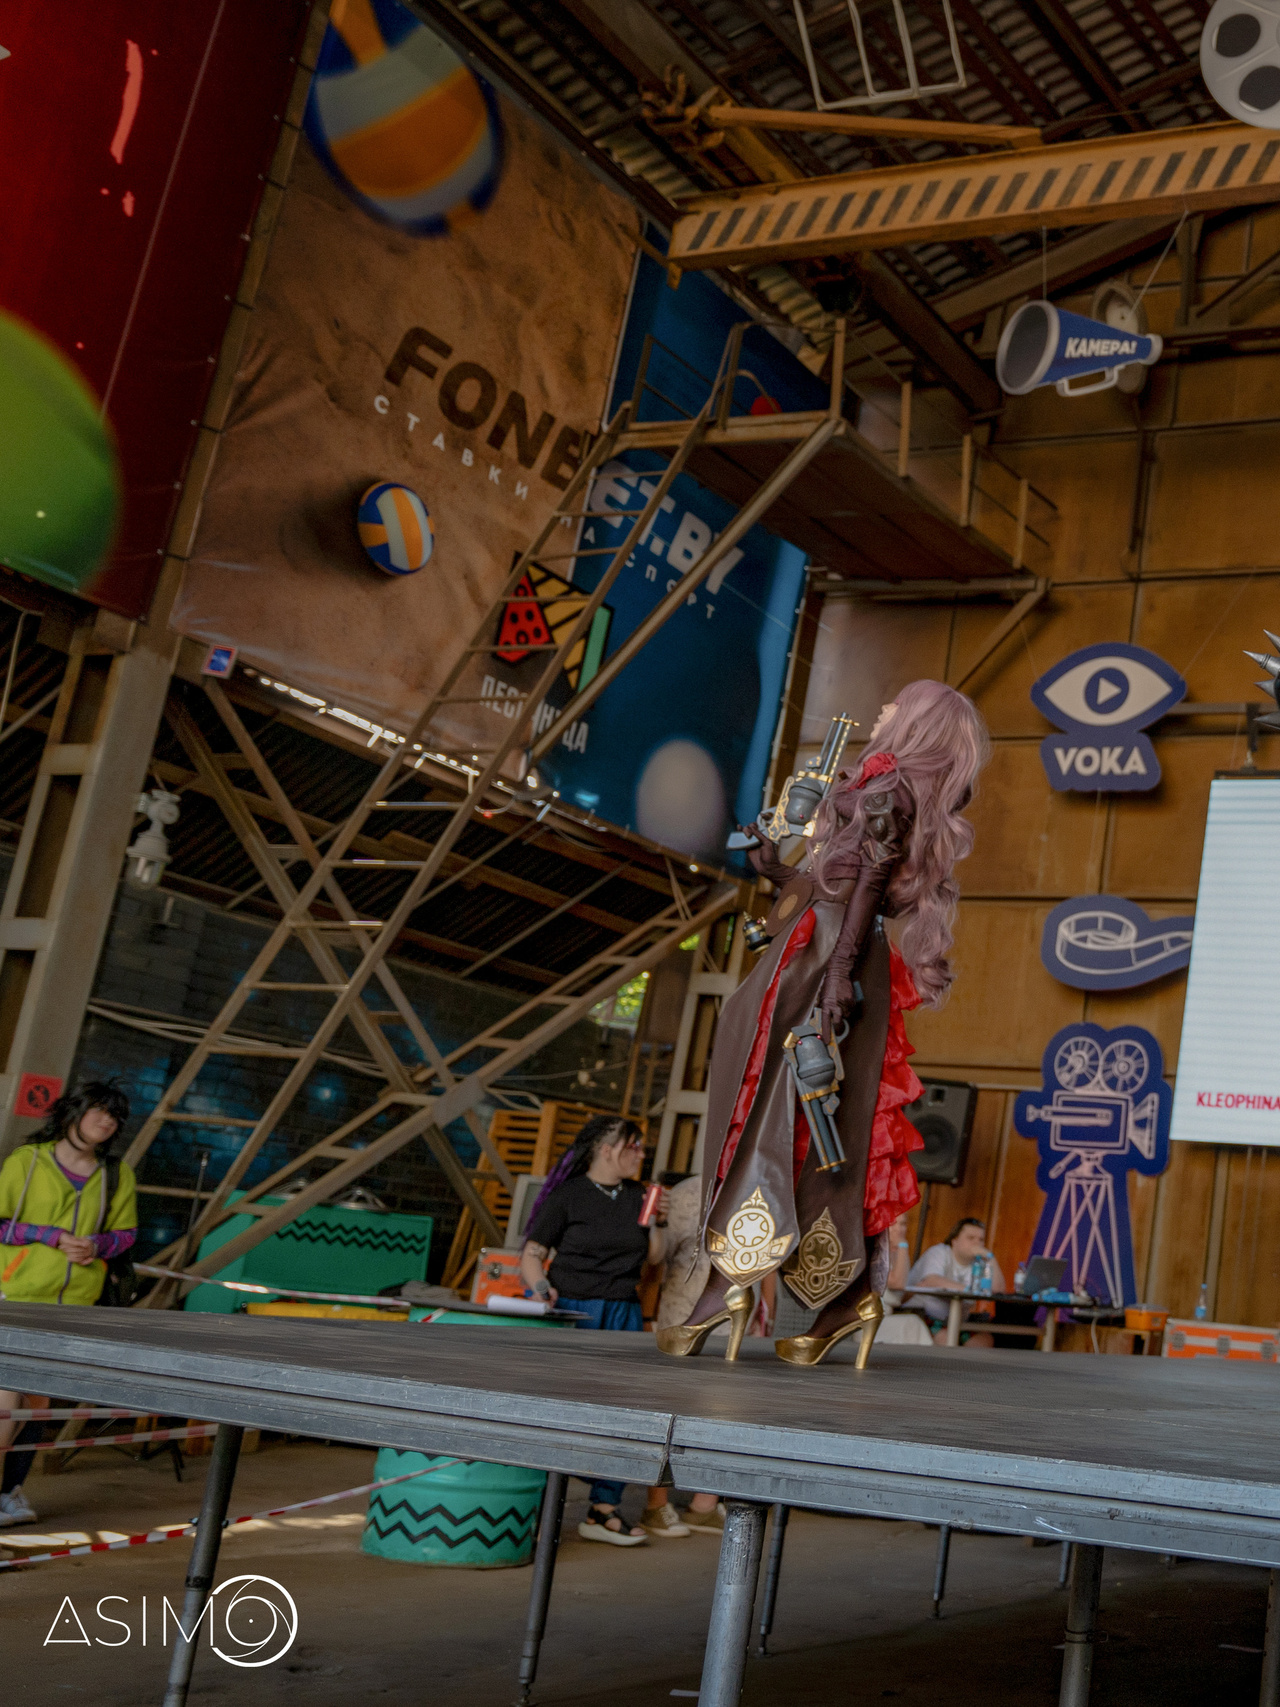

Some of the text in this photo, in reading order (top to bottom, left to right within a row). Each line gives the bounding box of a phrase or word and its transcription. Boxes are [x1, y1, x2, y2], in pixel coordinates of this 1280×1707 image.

[1064, 337, 1138, 358] КАМЕРА!
[373, 395, 529, 501] СТАВКИ
[1054, 746, 1148, 777] VOKA
